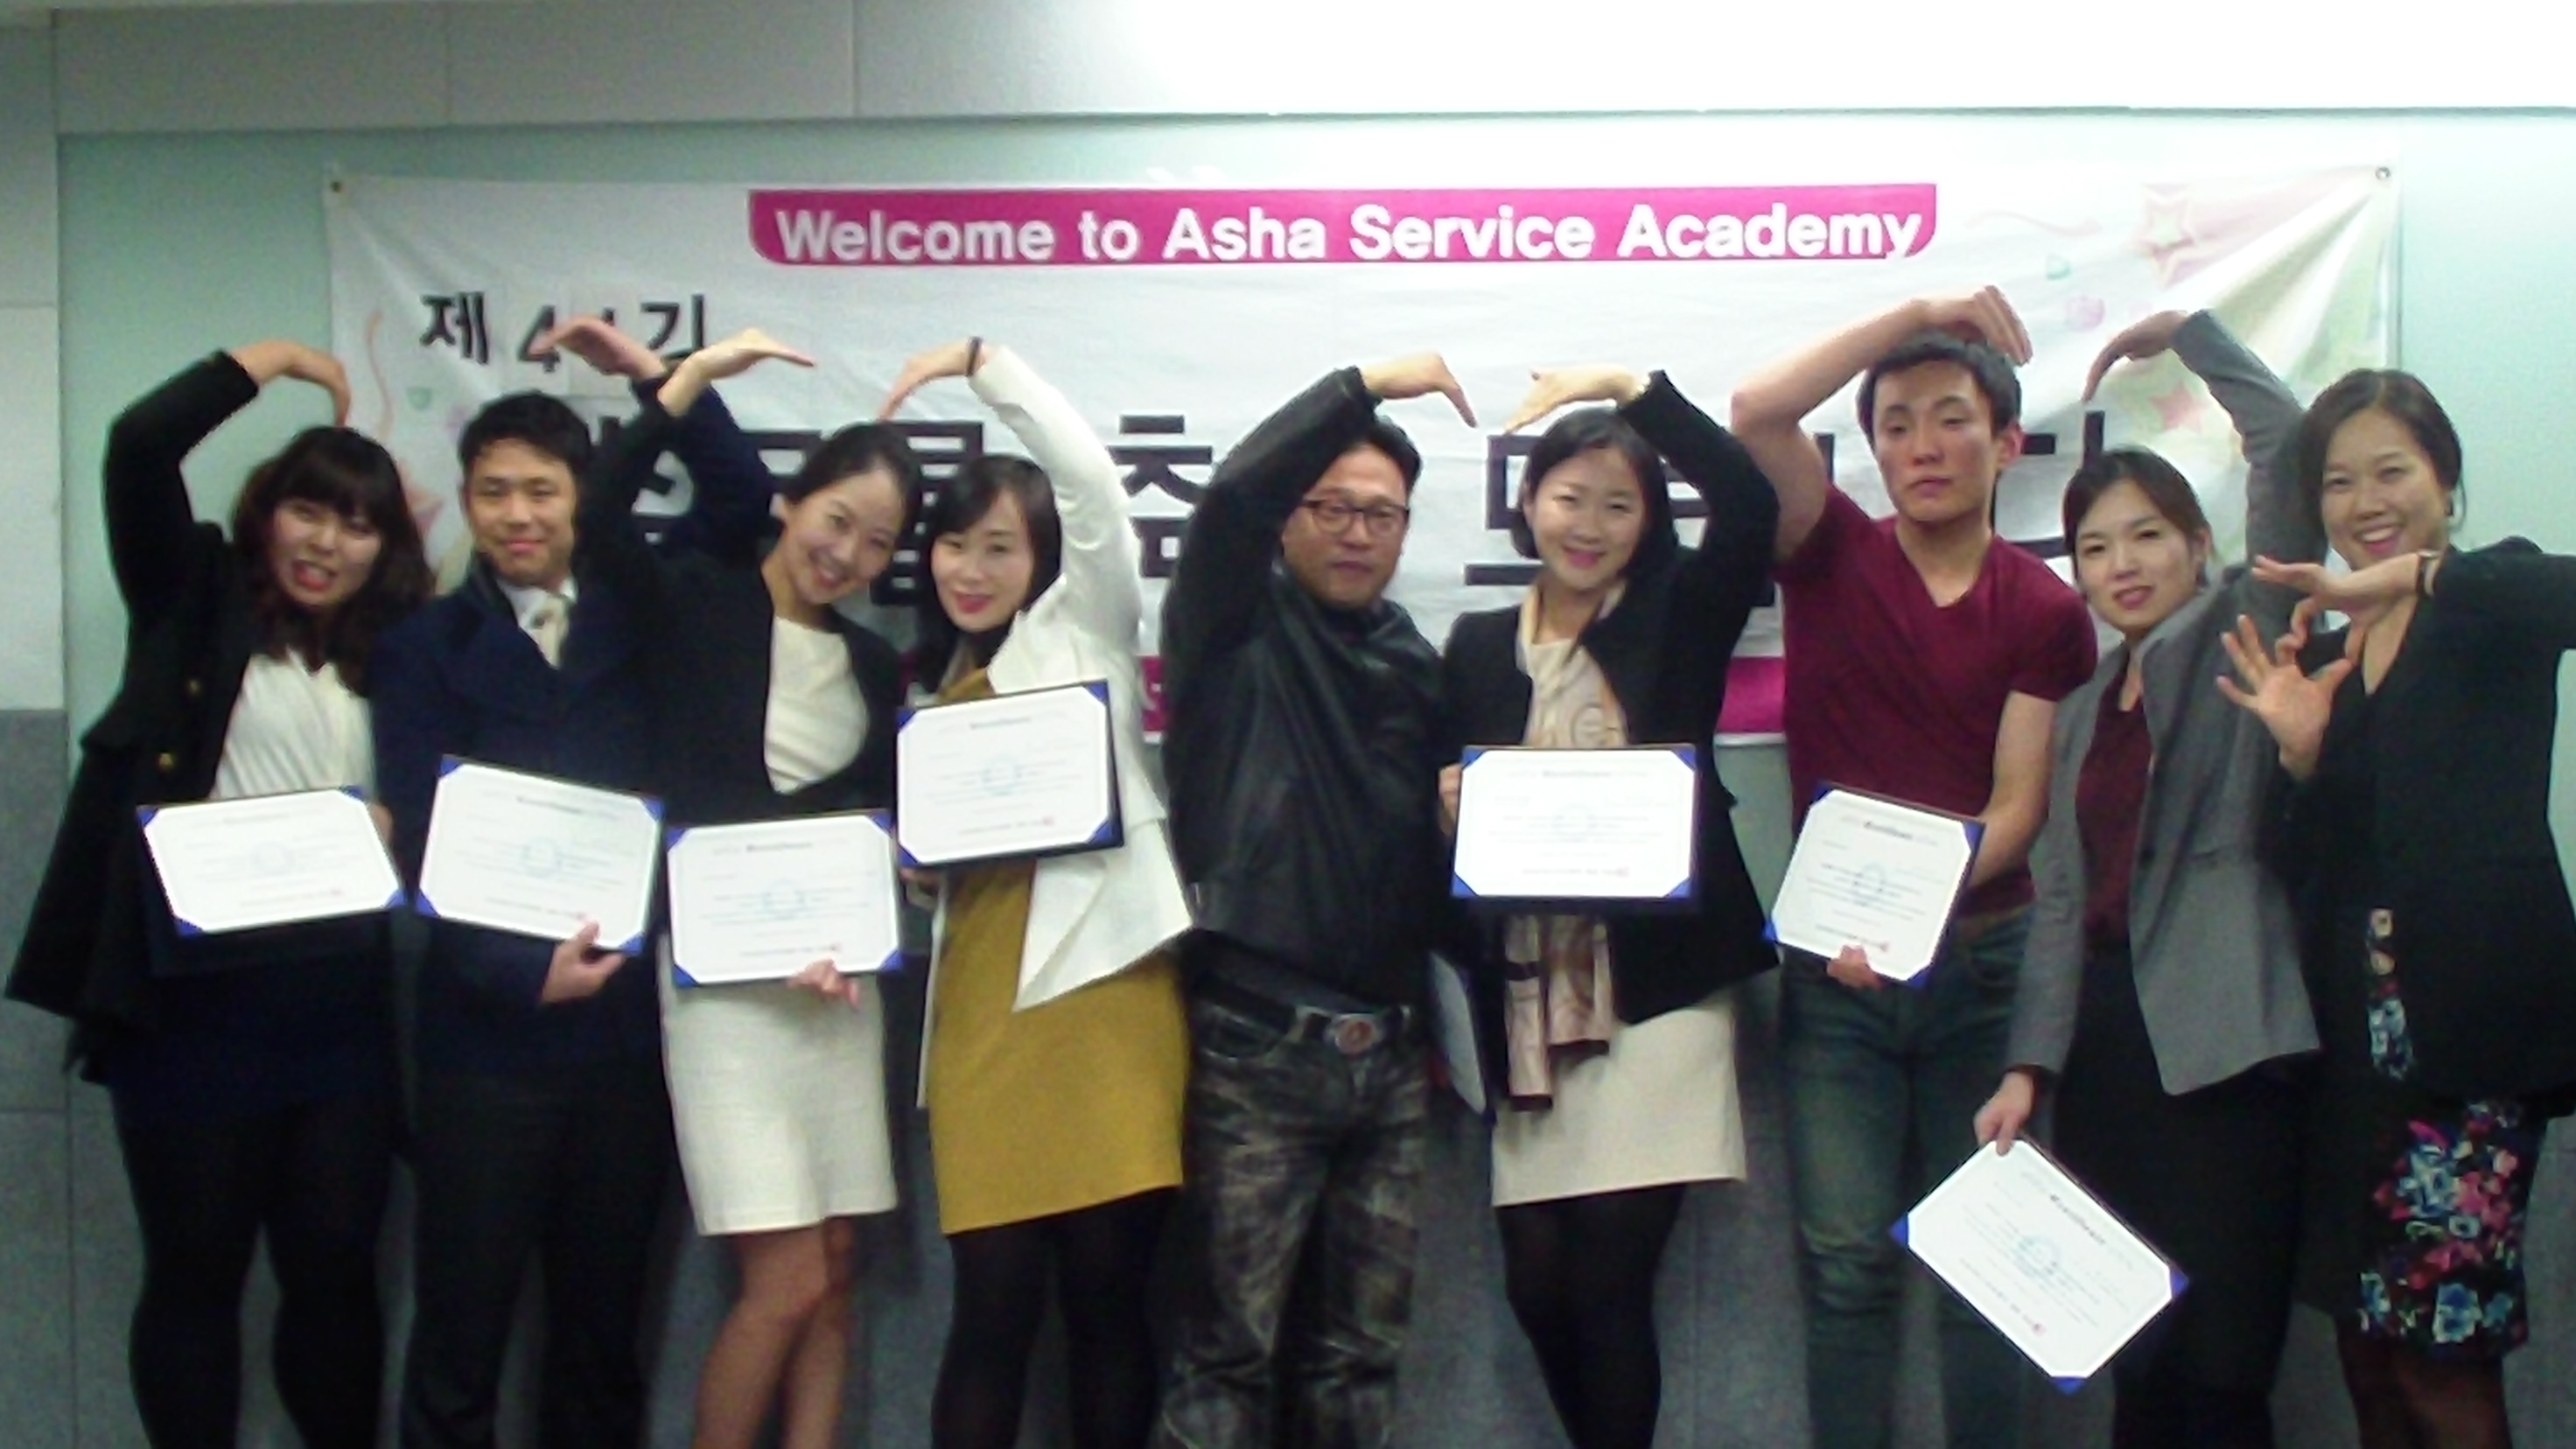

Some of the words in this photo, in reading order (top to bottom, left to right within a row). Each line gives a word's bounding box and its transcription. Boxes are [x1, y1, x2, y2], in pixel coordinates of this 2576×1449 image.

[777, 208, 1054, 262] Welcome
[1078, 210, 1138, 261] to
[1162, 207, 1326, 260] Asha
[1349, 204, 1595, 260] Service
[1617, 203, 1922, 261] Academy
[419, 291, 489, 365] 제
